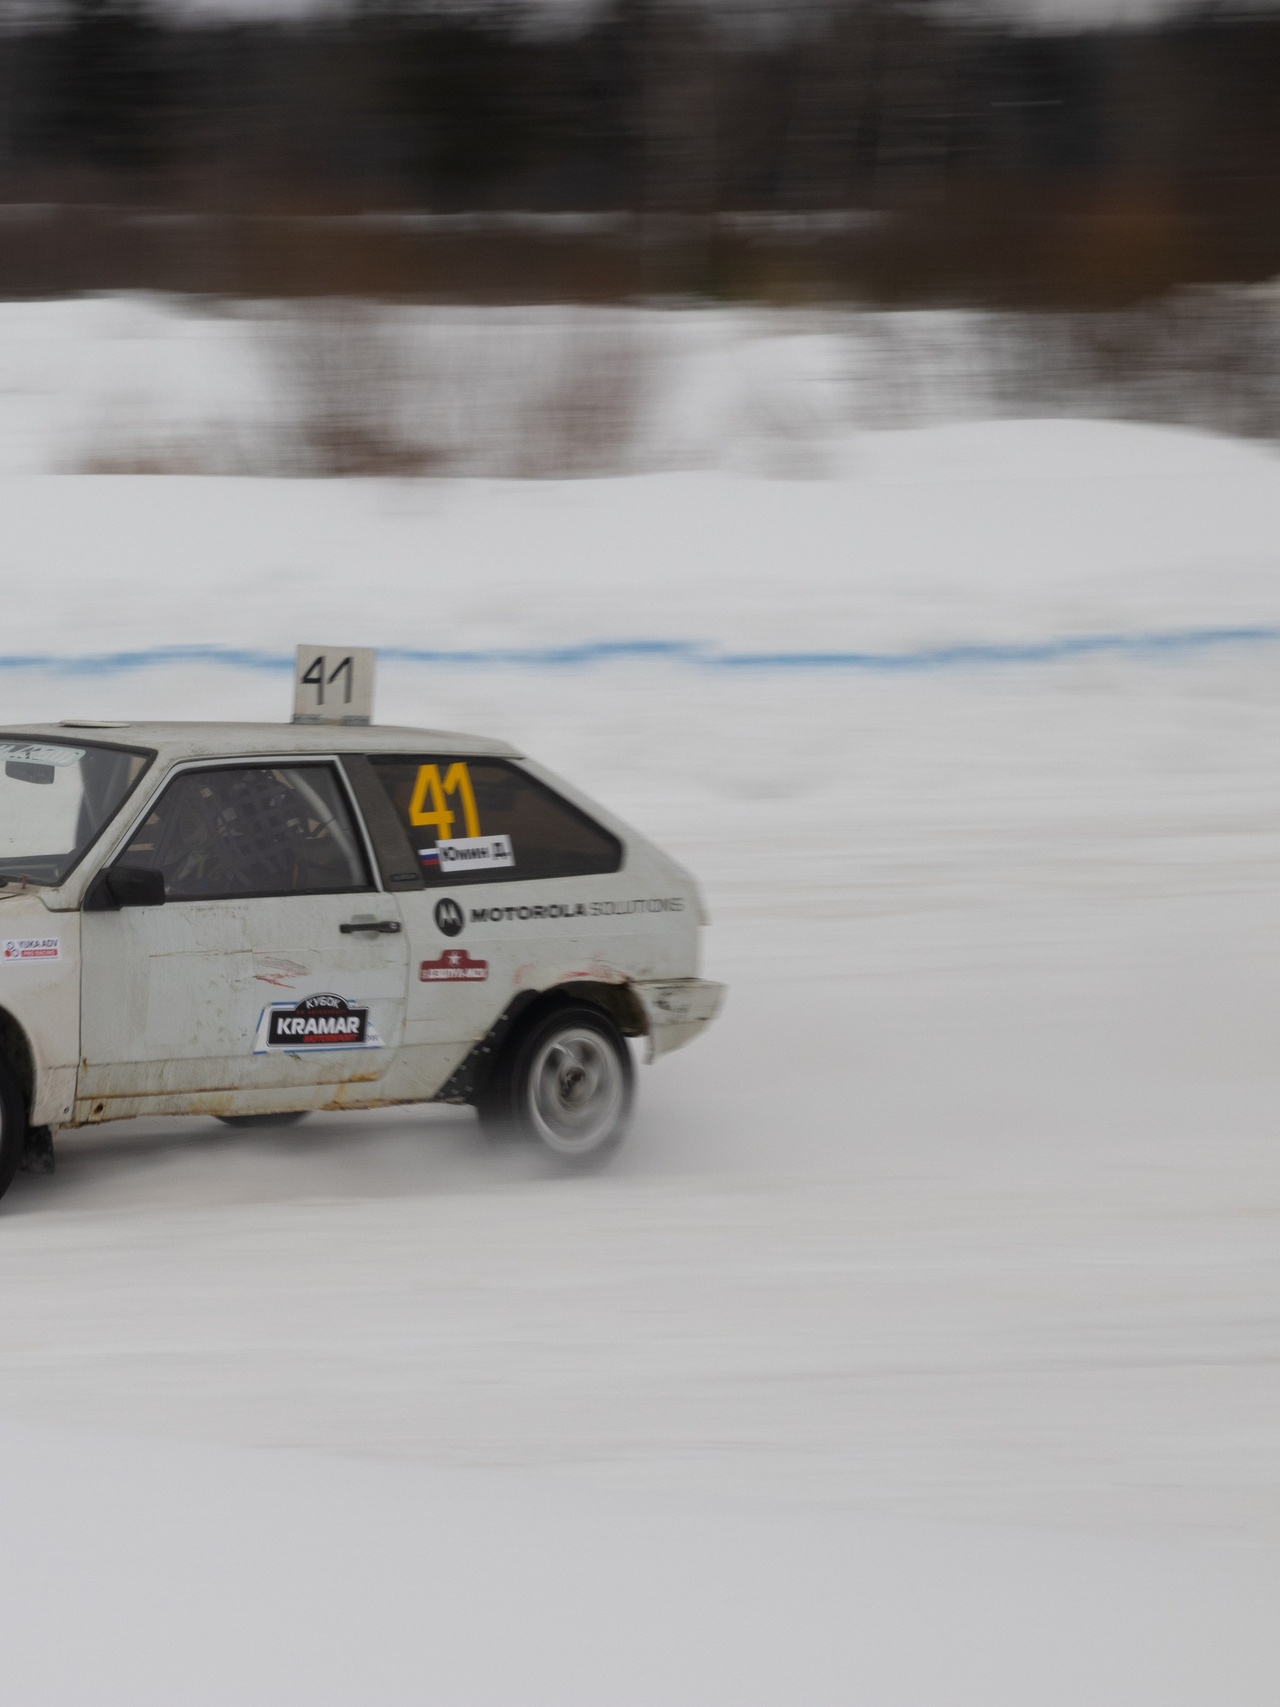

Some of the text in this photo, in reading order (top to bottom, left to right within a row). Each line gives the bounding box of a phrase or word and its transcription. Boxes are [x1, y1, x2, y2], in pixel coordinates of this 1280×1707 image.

[301, 655, 354, 705] 41
[408, 761, 481, 840] 41
[470, 897, 685, 923] MOTOROLA SOLUTIONS
[306, 996, 342, 1009] КУБОК
[277, 1016, 360, 1035] KRAMAR
